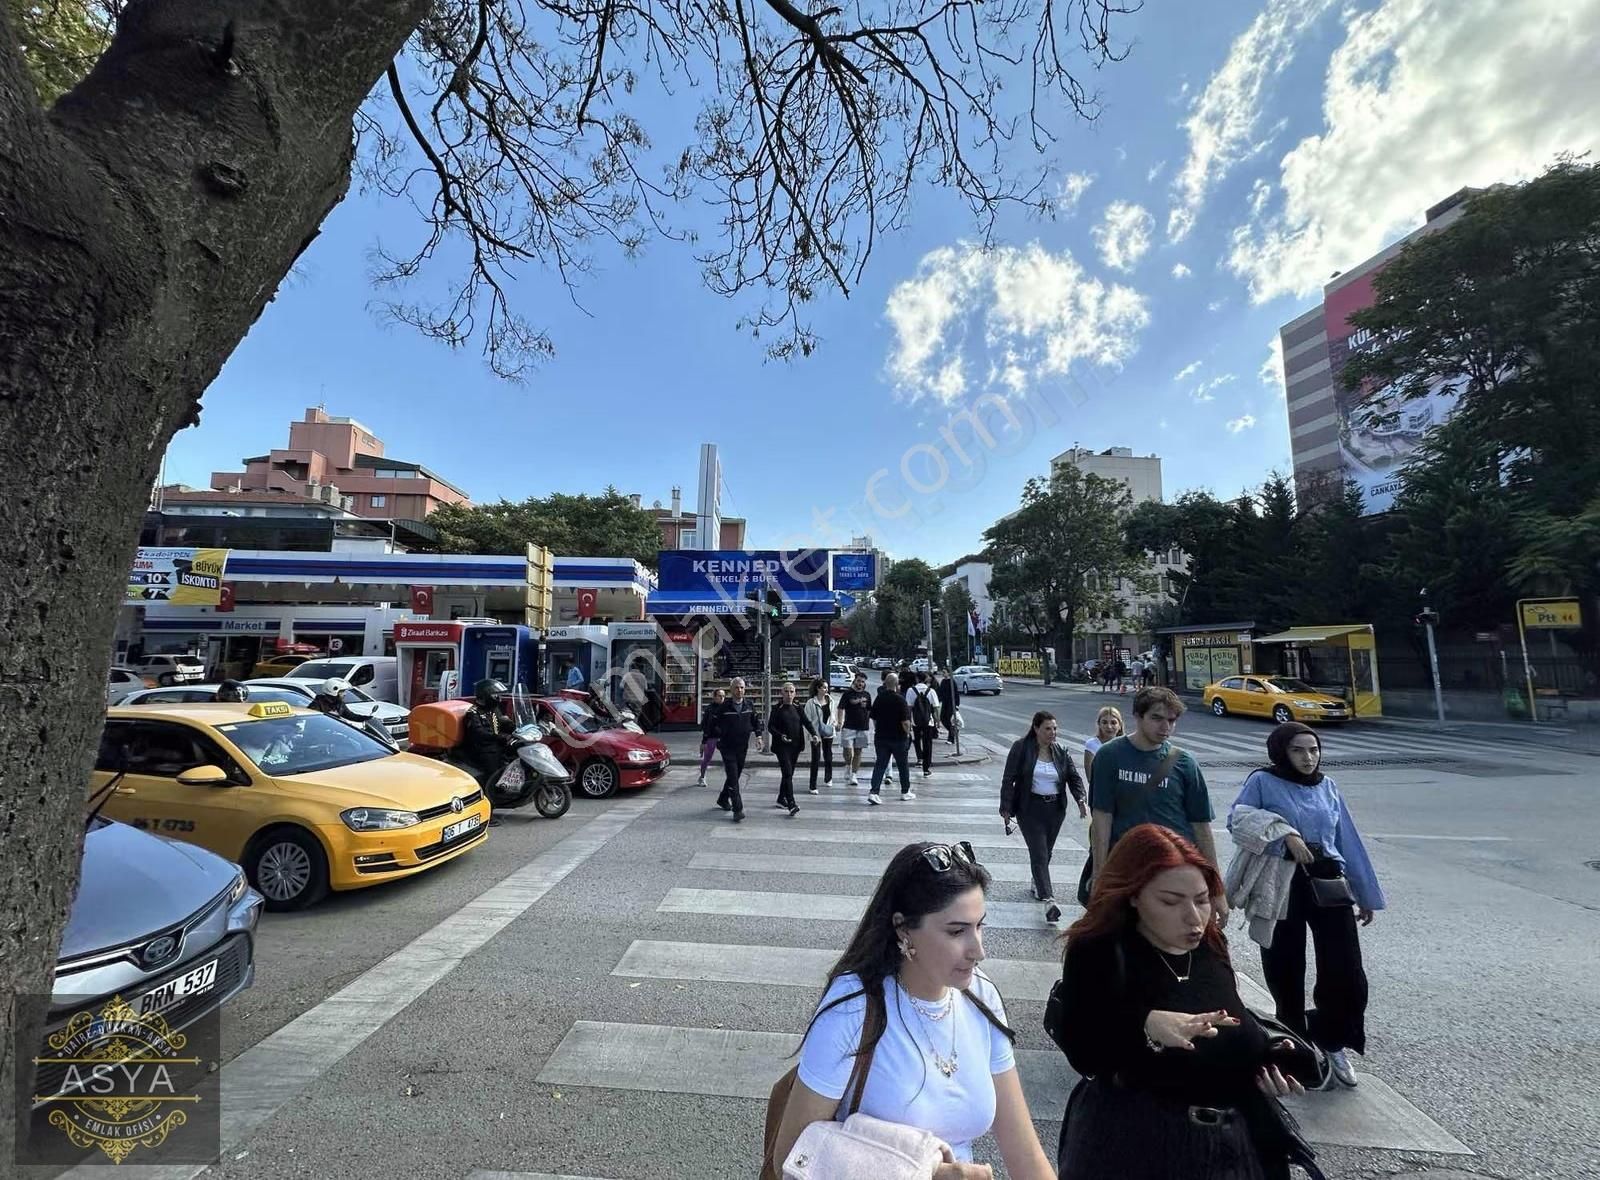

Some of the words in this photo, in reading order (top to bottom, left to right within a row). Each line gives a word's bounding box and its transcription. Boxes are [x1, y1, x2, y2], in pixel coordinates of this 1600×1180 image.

[195, 561, 222, 574] BÜYÜK
[692, 559, 795, 573] KENNEDY
[181, 574, 217, 589] İSKONTO
[709, 575, 741, 583] TEKEL
[742, 575, 750, 583] &
[689, 605, 734, 613] KENNEDY
[224, 620, 264, 631] Market
[407, 629, 425, 637] Ziraat
[1133, 771, 1148, 784] AND
[141, 981, 177, 1016] BRN
[183, 963, 215, 994] 537
